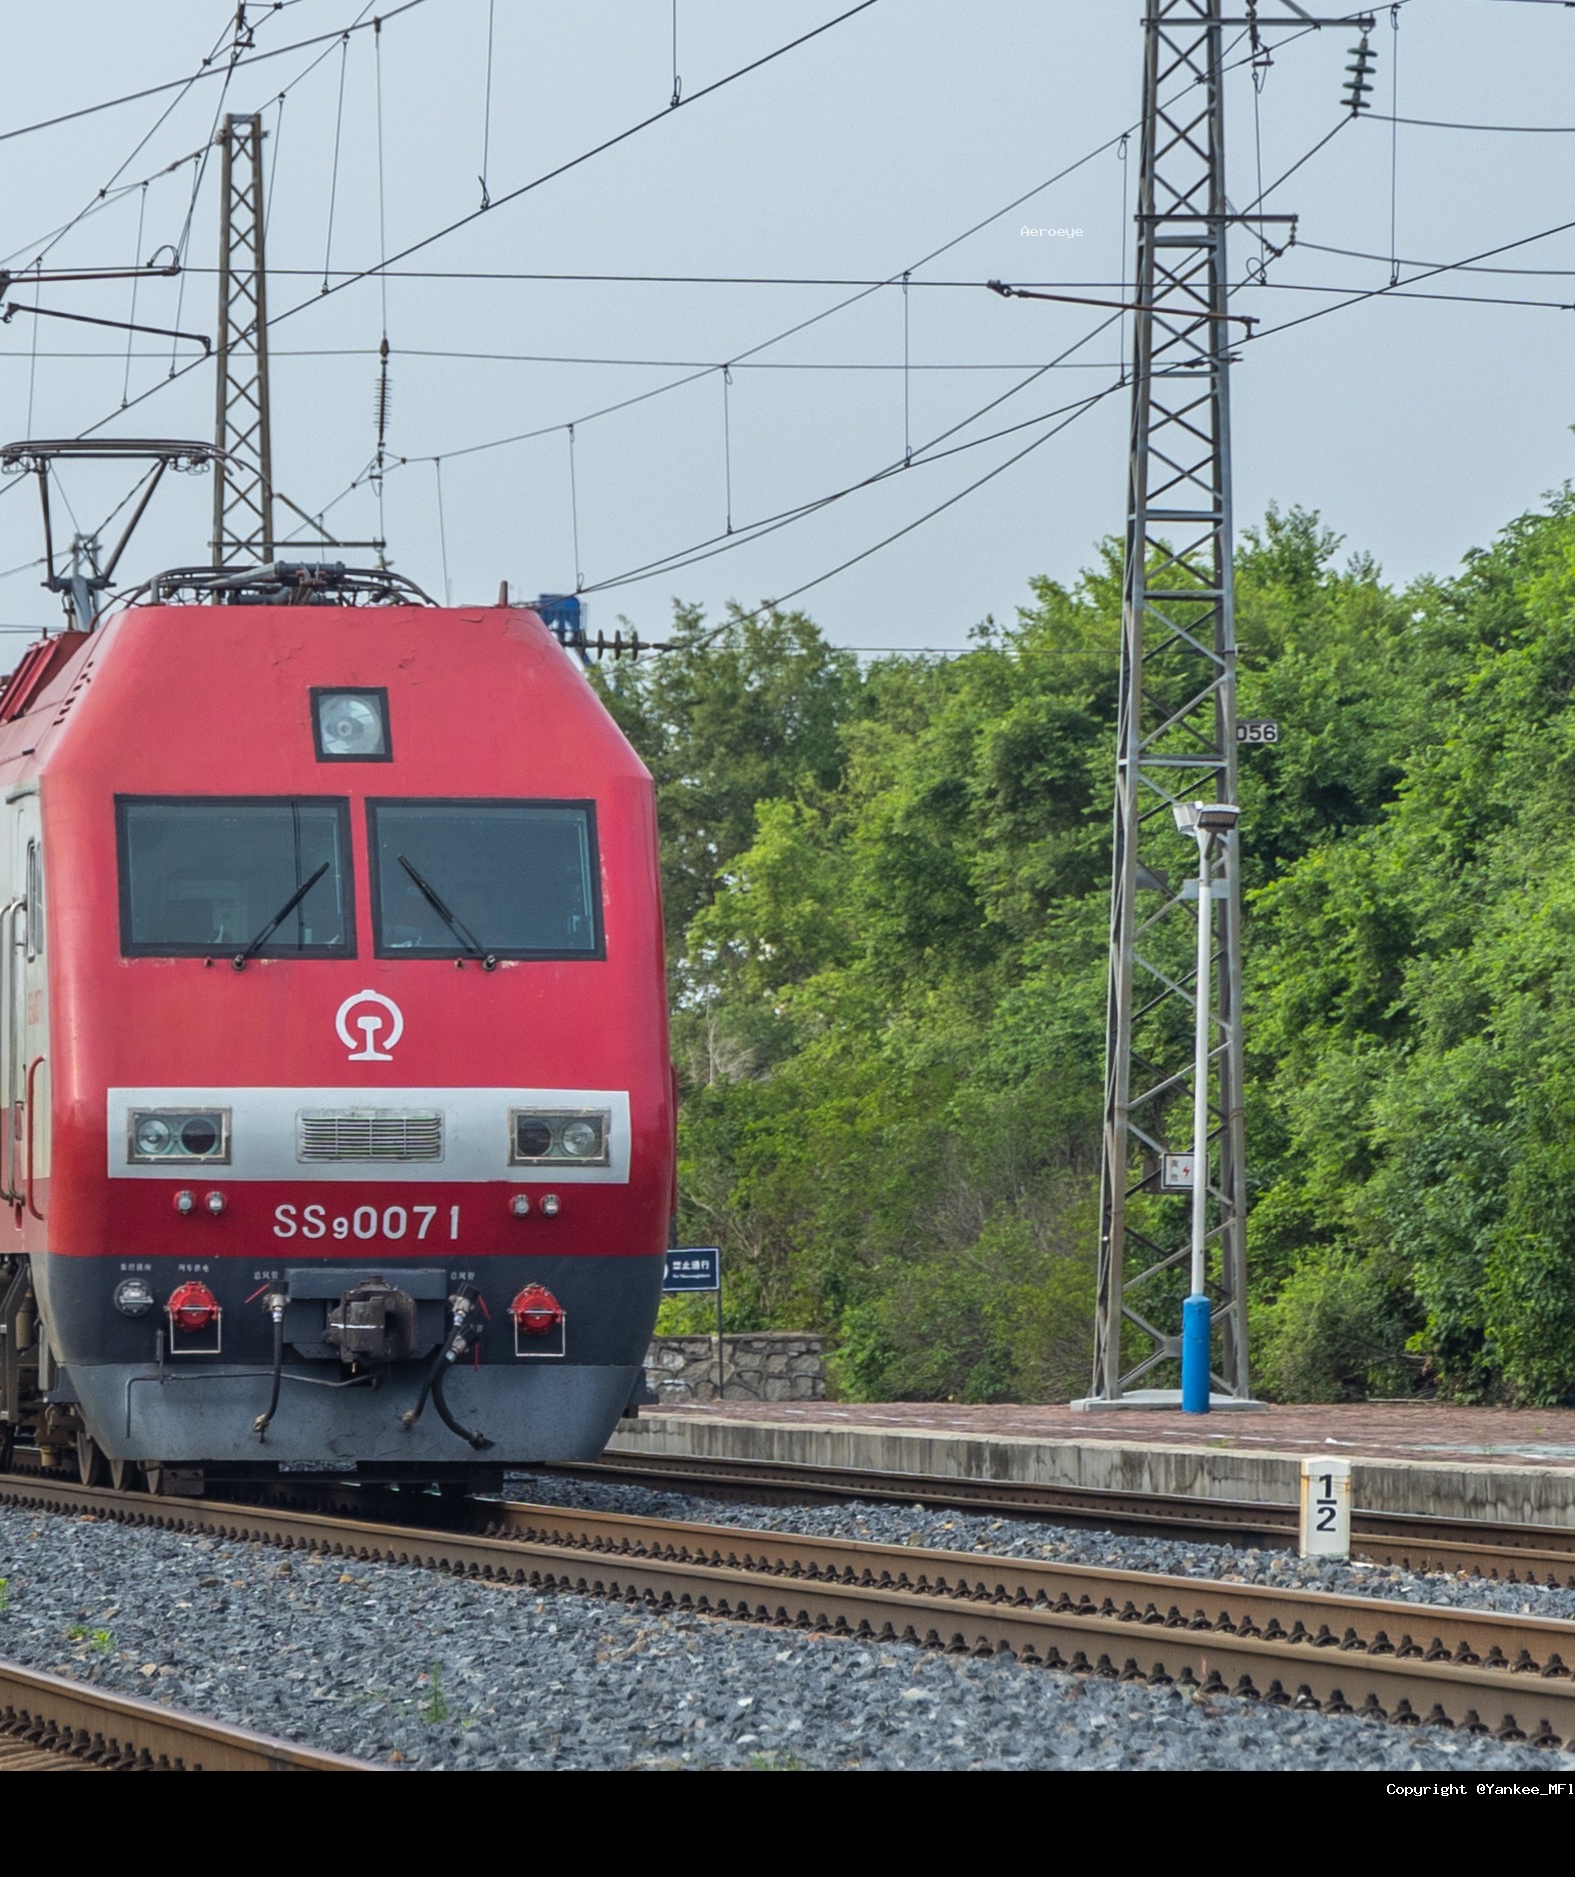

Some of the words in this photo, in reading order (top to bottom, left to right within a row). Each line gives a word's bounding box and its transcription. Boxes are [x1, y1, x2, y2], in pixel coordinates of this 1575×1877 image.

[1235, 724, 1276, 741] 056
[1319, 1474, 1332, 1498] 1
[1316, 1506, 1337, 1532] 2
